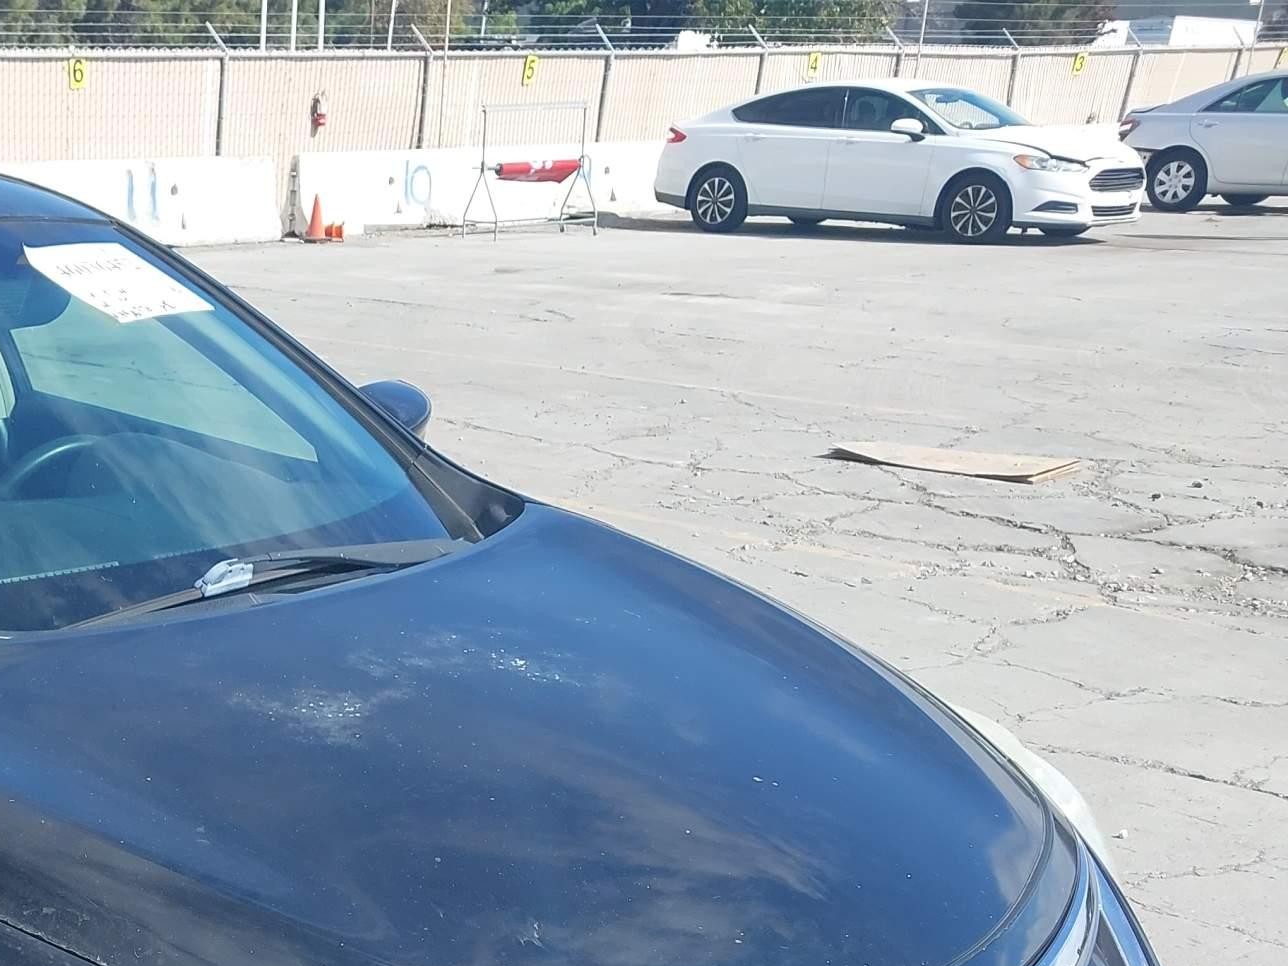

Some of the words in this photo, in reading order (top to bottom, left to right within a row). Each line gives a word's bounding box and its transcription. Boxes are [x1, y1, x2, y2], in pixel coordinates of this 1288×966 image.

[73, 59, 84, 83] 6
[526, 59, 536, 80] 5
[810, 55, 818, 73] 4
[1075, 55, 1085, 72] 3
[404, 159, 432, 205] 10
